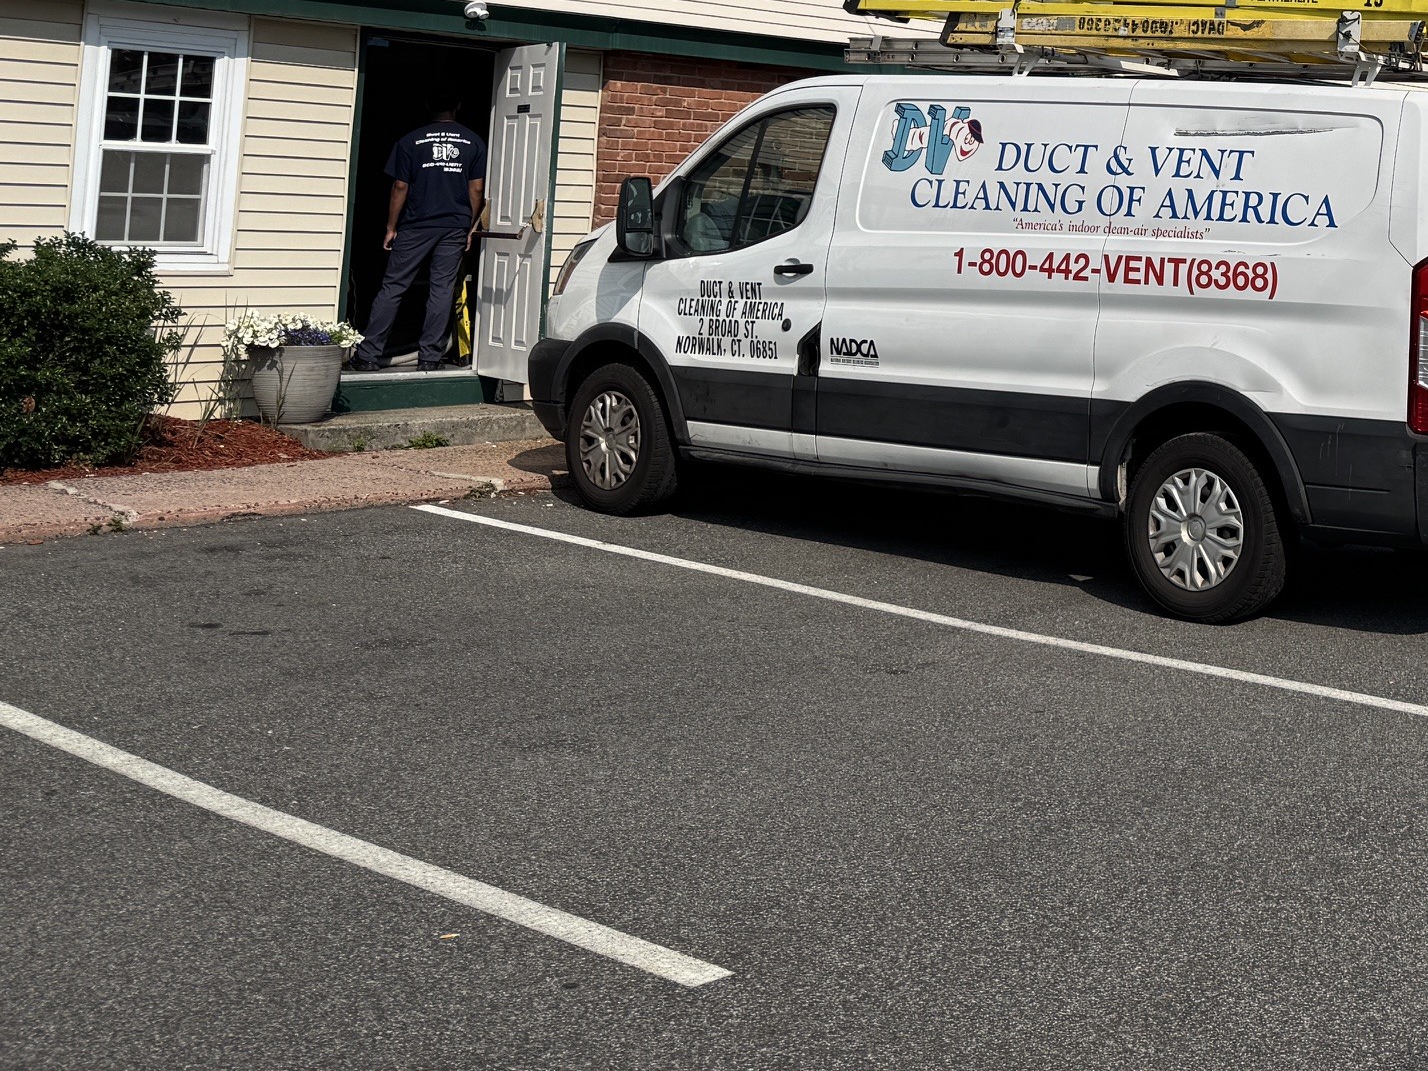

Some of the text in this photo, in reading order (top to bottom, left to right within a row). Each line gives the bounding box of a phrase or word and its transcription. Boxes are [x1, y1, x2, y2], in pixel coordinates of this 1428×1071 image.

[994, 141, 1255, 182] DUCT & VENT
[910, 177, 1339, 229] CLEANING OF AMERICA
[1068, 219, 1101, 234] indoor
[1103, 220, 1149, 237] clean-air
[953, 246, 1279, 300] 1-800-442-VENT(8368)
[700, 279, 763, 301] DUCT & VENT
[677, 297, 785, 321] CLEANING OF AMERICA
[698, 317, 759, 339] 2 BROAD ST.
[675, 335, 779, 360] NORWALK, CT. 06851
[829, 337, 879, 358] NADCA
